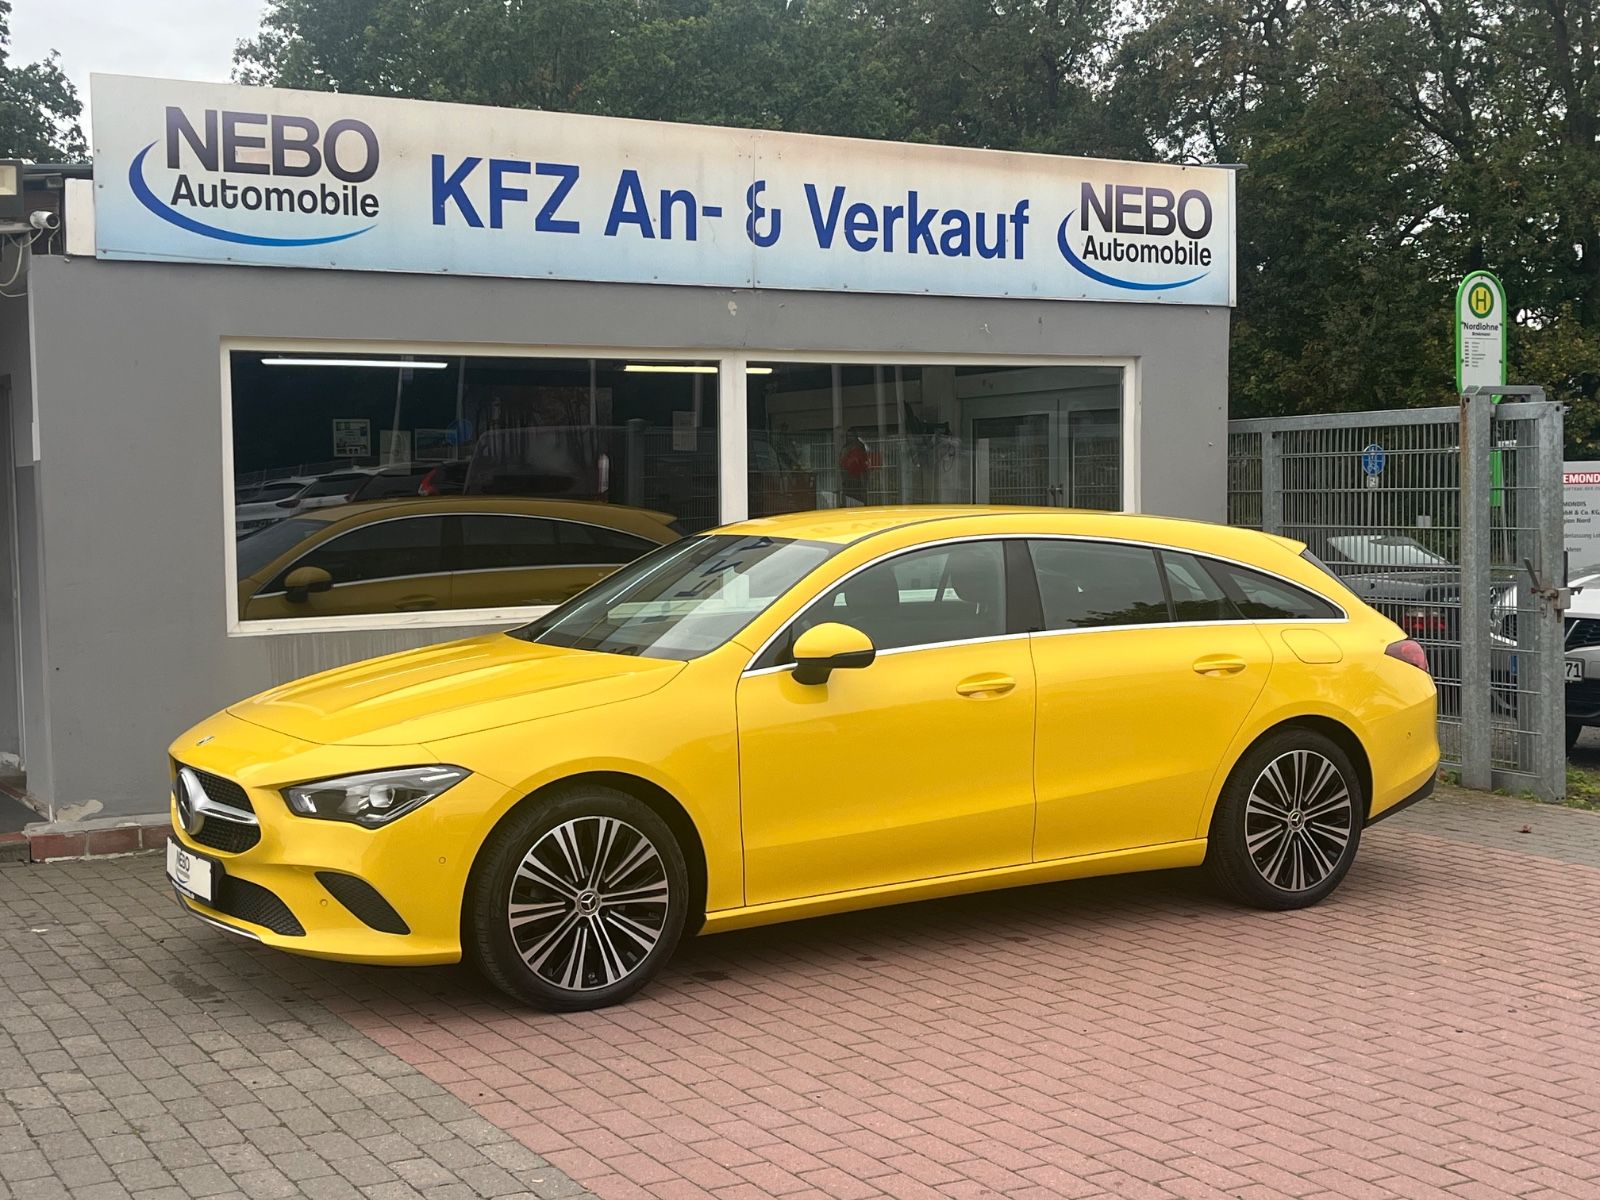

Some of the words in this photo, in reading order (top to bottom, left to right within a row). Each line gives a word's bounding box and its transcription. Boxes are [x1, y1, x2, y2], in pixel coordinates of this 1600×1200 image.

[166, 106, 380, 183] NEBO
[170, 174, 380, 218] Automobile
[430, 154, 580, 235] KFZ
[604, 169, 722, 241] An-
[746, 179, 782, 248] &
[803, 183, 1029, 260] Verkauf
[1080, 182, 1212, 240] NEBO
[1082, 235, 1212, 267] Automobile
[1476, 291, 1487, 311] H
[1463, 322, 1499, 331] Nordlohne
[1566, 663, 1581, 678] 71
